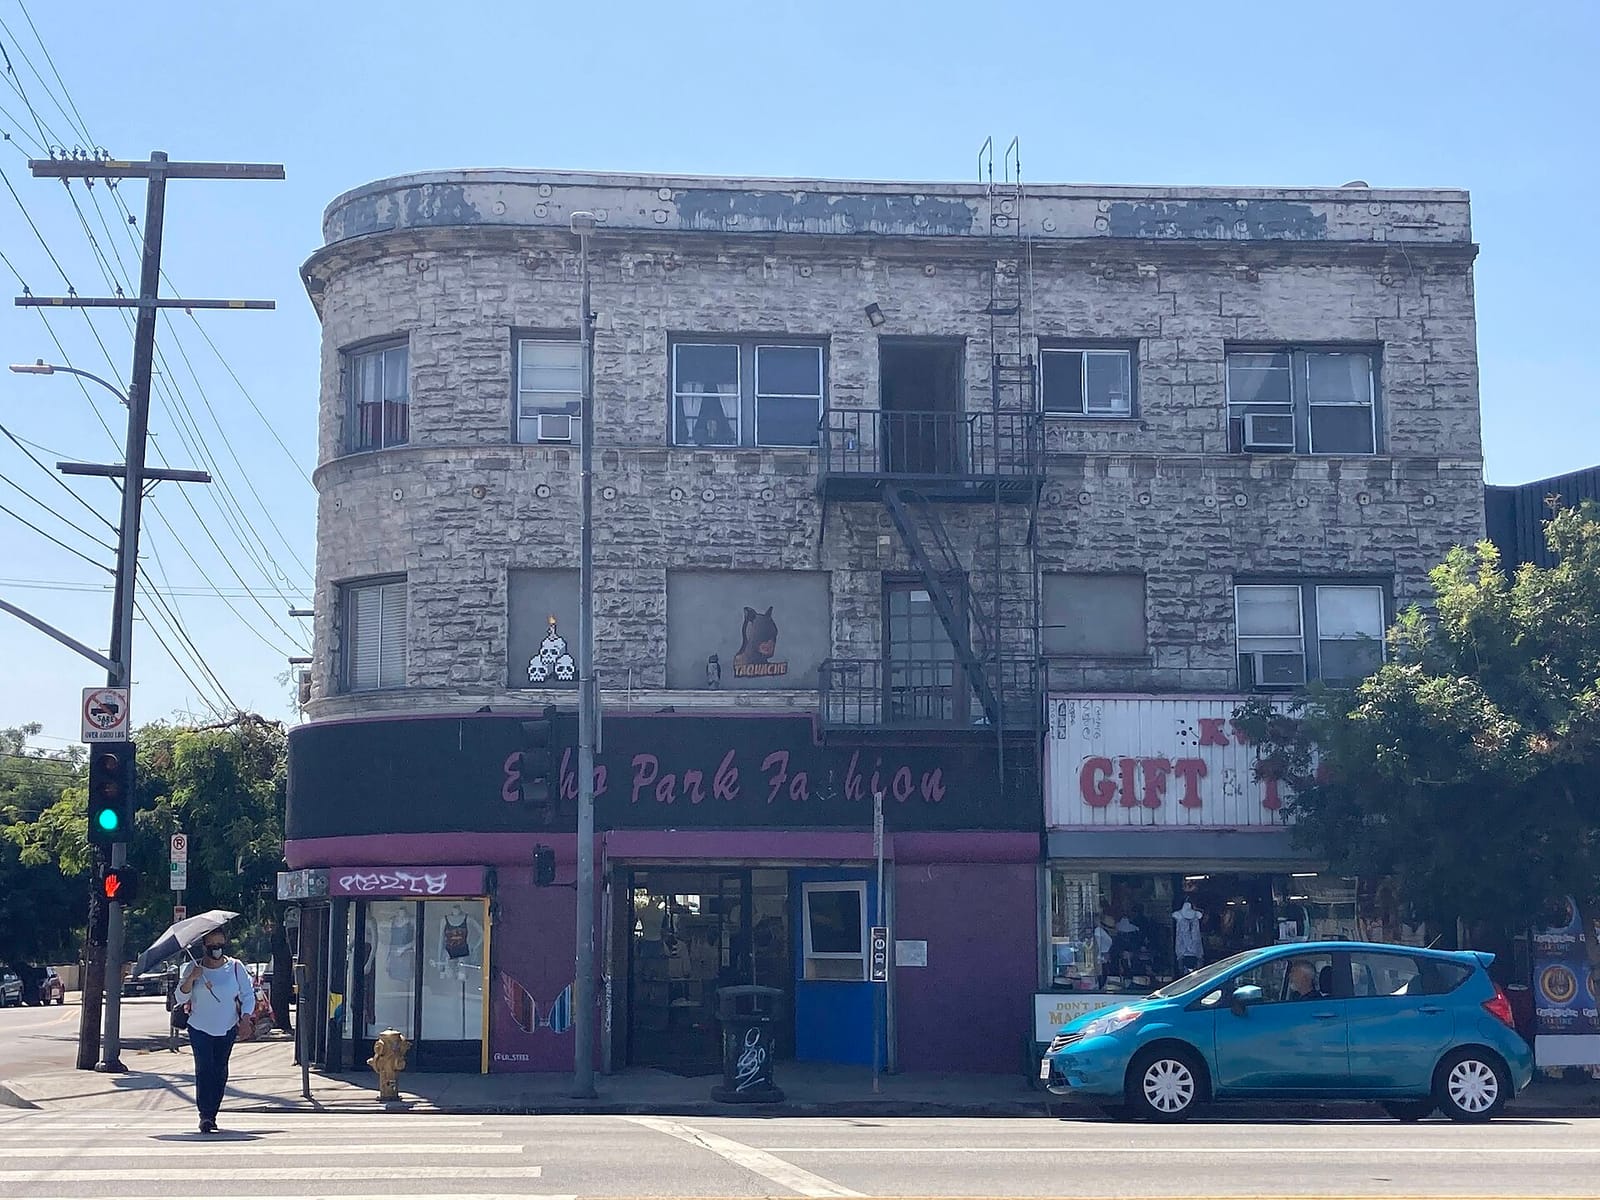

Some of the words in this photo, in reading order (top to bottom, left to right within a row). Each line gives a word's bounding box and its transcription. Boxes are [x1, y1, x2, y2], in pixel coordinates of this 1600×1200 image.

[85, 731, 98, 739] OVER
[631, 749, 743, 805] Park
[1080, 757, 1208, 810] GIFT
[1056, 1001, 1090, 1011] DON'T
